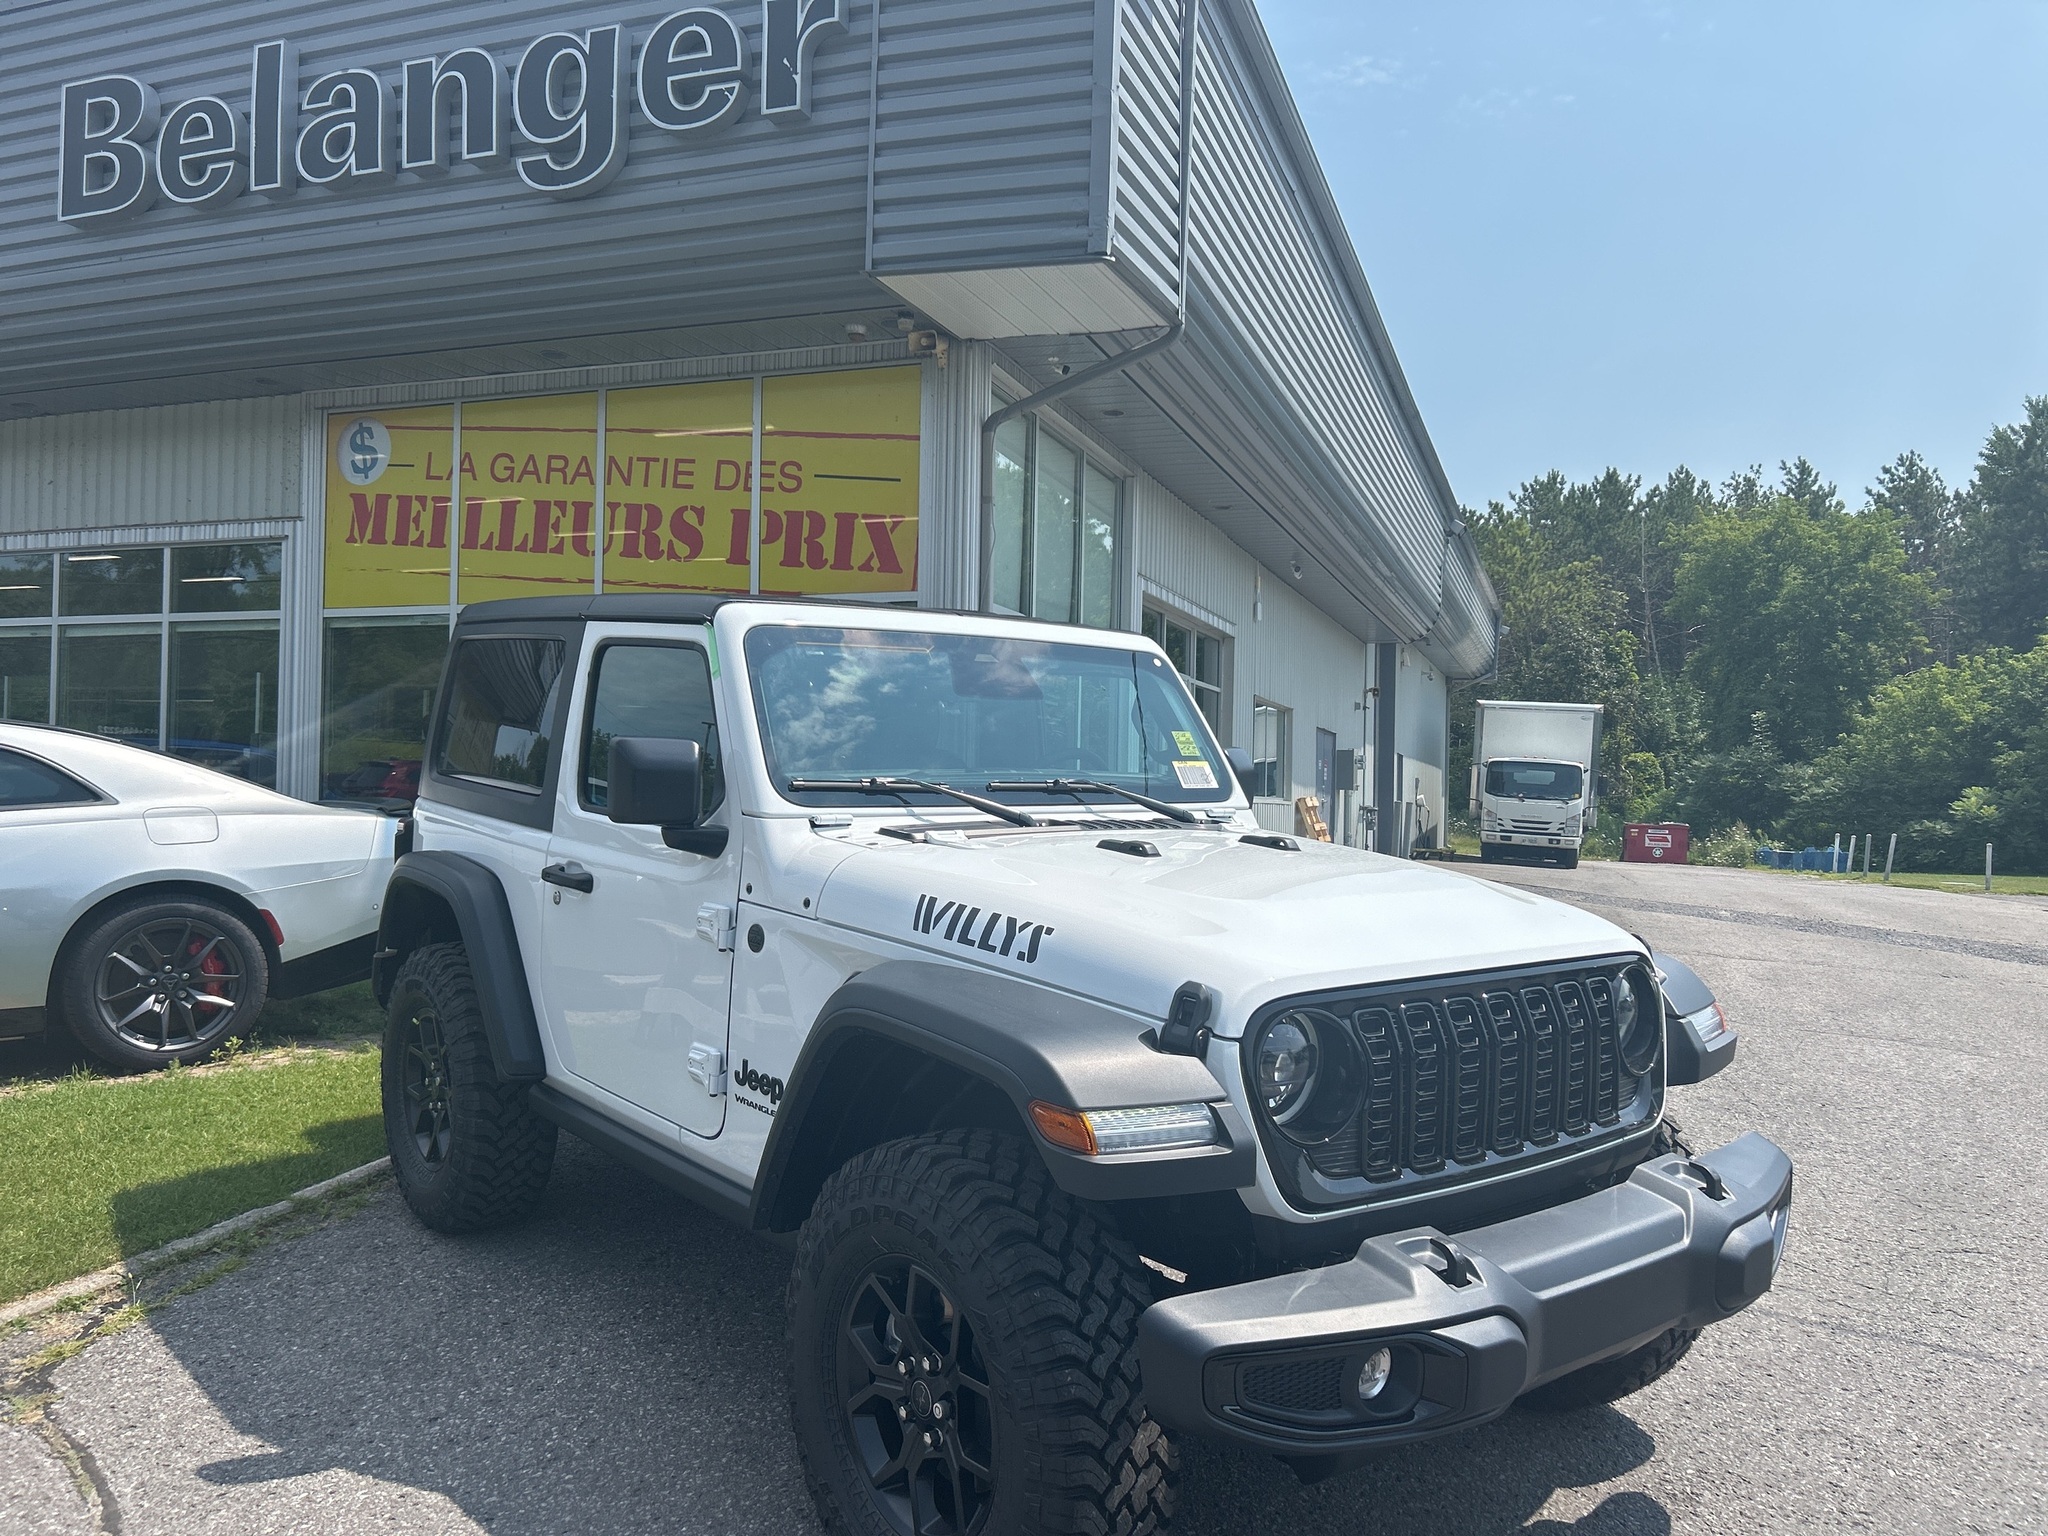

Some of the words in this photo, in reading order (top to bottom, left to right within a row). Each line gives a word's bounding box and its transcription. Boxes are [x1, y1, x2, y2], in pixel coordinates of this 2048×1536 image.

[57, 0, 846, 223] Belanger
[424, 450, 478, 482] LA
[488, 452, 697, 491] GARANTIE
[713, 457, 804, 493] DES
[345, 491, 706, 563] MEILLEURS
[725, 506, 907, 575] PRIX
[912, 893, 1055, 963] WILLYS
[734, 1058, 784, 1105] Jeep
